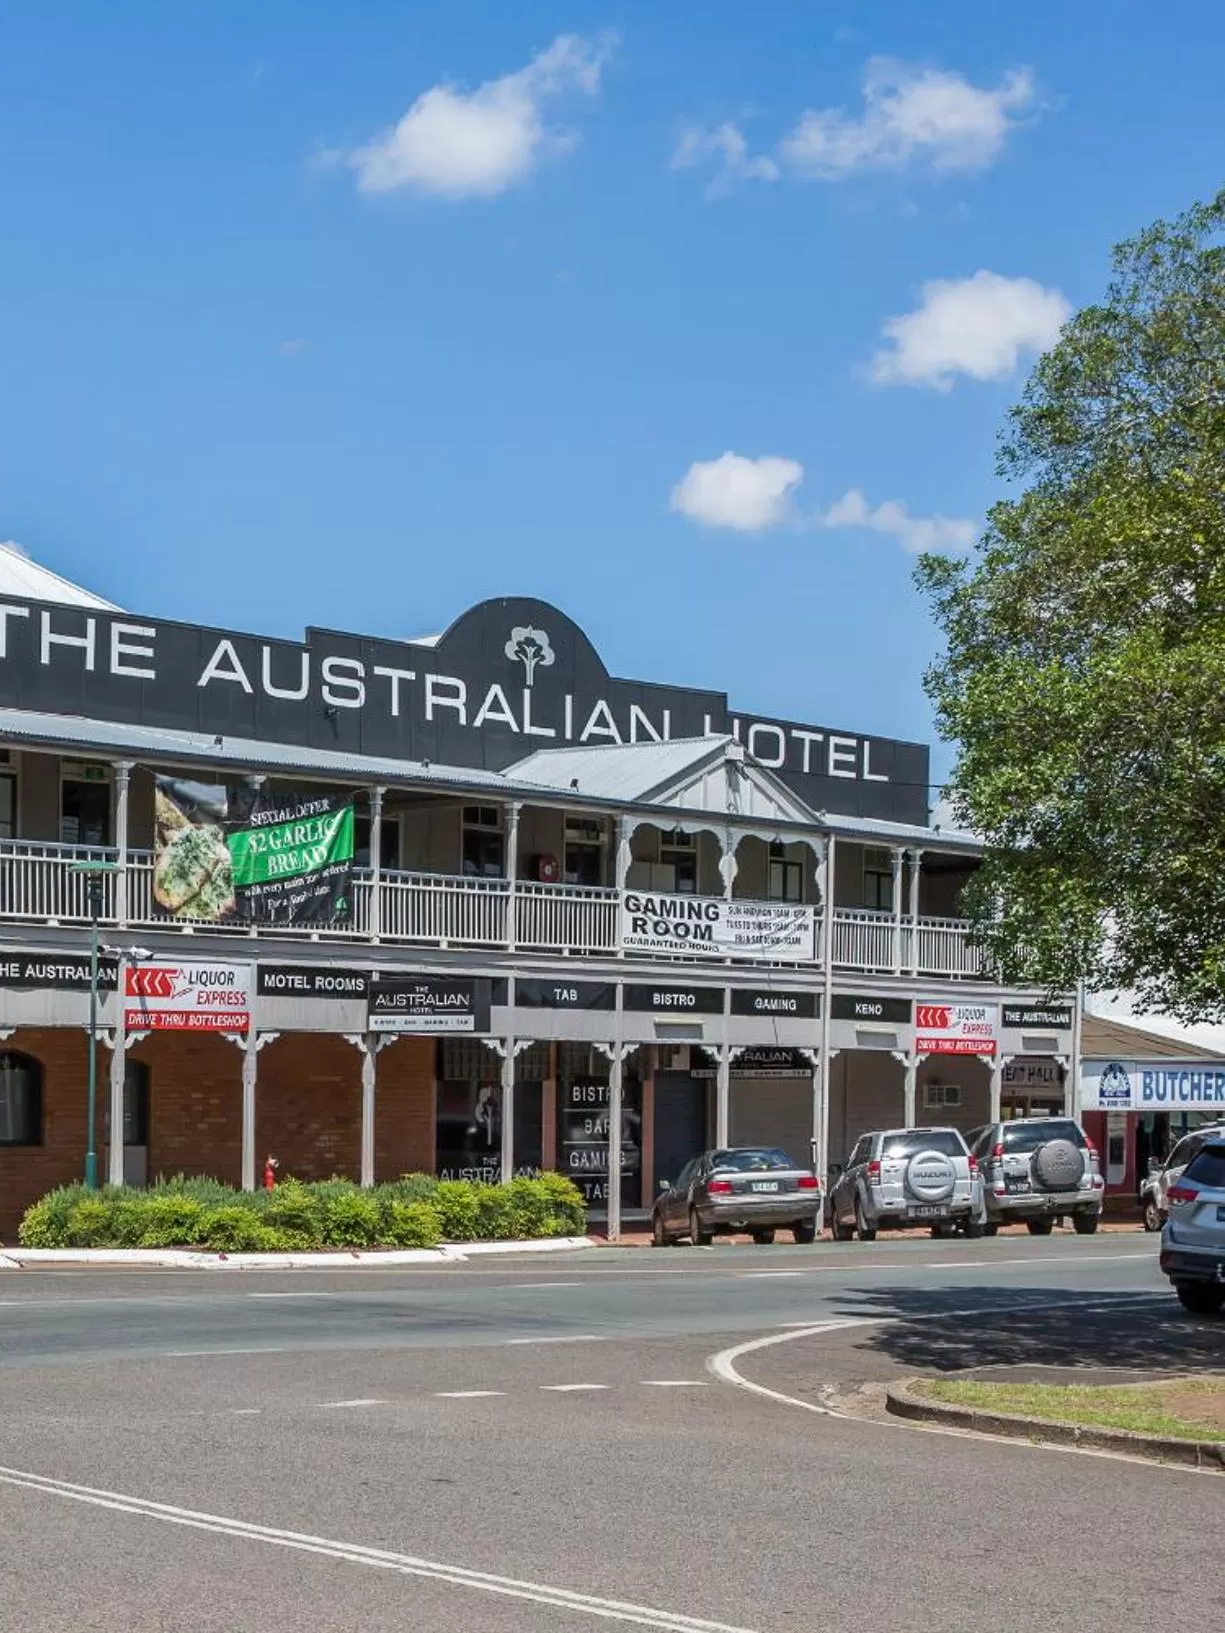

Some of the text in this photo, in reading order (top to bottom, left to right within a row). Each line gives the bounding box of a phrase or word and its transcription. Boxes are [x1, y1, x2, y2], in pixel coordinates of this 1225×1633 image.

[196, 638, 672, 744] AUSTRALIAN
[250, 799, 331, 827] SPECIAL OFFER
[248, 816, 338, 853] $2 GARLIC
[267, 845, 328, 876] BREAD
[625, 894, 721, 922] GAMING
[632, 917, 713, 941] ROOM
[624, 937, 720, 953] GUARANTEED HOURS
[25, 963, 117, 982] AUSTRALAN
[188, 970, 235, 987] LIQUOR
[264, 974, 365, 991] MOTEL ROOMS
[415, 985, 430, 994] THE
[197, 991, 247, 1006] EXPRESS
[376, 993, 470, 1007] AUSTRALIAN
[554, 988, 578, 1001] TAB
[652, 992, 696, 1006] BISTRO
[754, 997, 797, 1011] GAMING
[855, 1003, 883, 1015] KENO
[128, 1013, 248, 1027] DRIVE THRU BOTTLESHOP
[1005, 1011, 1022, 1021] THE
[962, 1023, 993, 1035] EXPRESS
[570, 1151, 626, 1168] GAMIG
